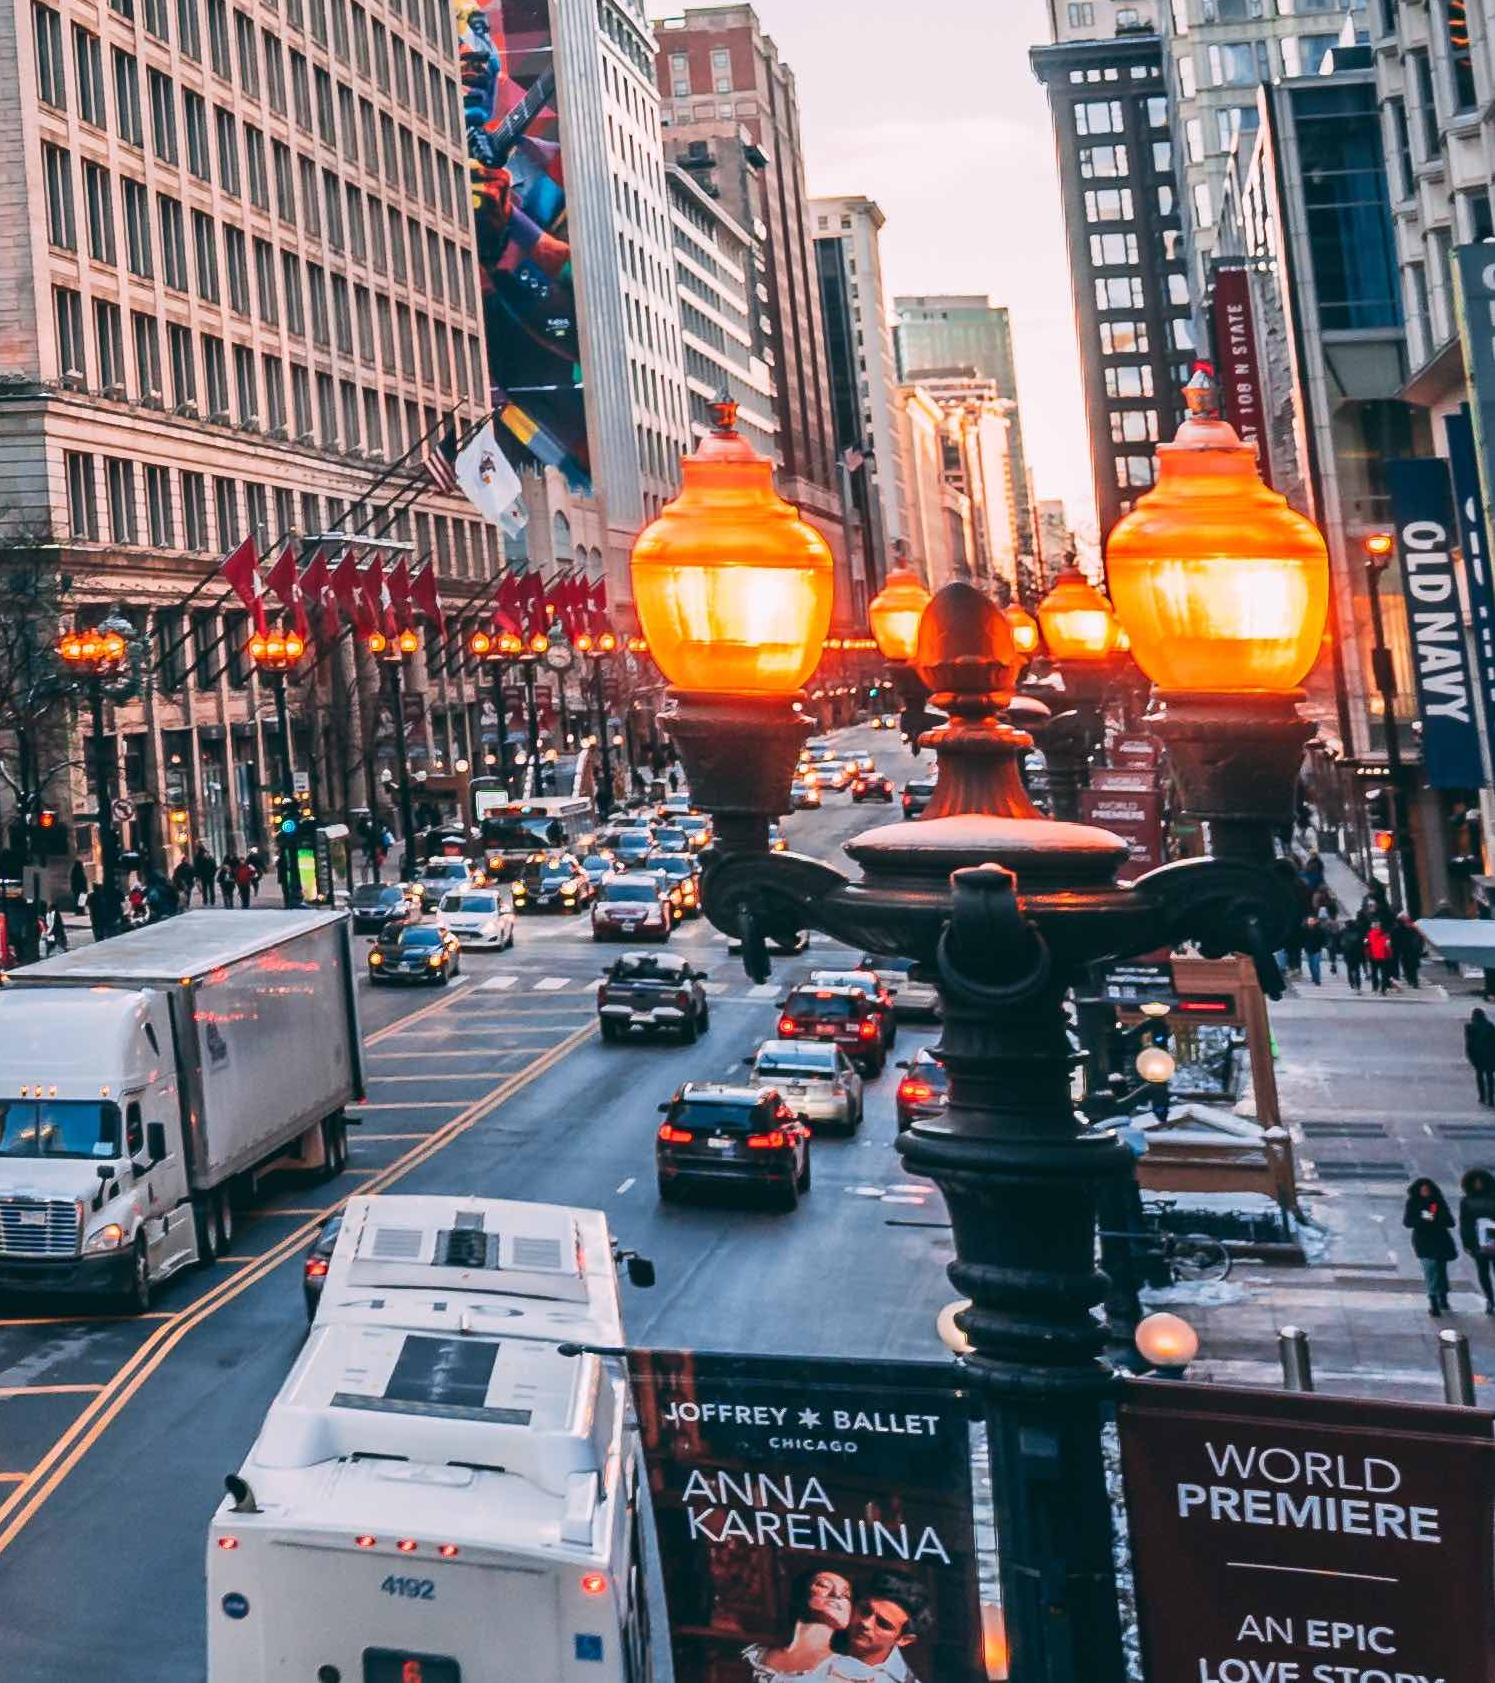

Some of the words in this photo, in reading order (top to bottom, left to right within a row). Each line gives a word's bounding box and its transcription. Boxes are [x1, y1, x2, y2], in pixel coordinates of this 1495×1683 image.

[1227, 303, 1249, 355] STATE
[1401, 520, 1452, 604] OLD
[1413, 612, 1469, 723] NAVY
[664, 1401, 788, 1427] JOFFREY
[833, 1409, 941, 1436] BALLET
[768, 1437, 858, 1453] CHICAGO
[1205, 1441, 1402, 1493] WORLD
[682, 1469, 835, 1513] ANNA
[1177, 1482, 1442, 1544] PREMIERE
[687, 1506, 951, 1565] KARENINA
[380, 1575, 437, 1601] 4192
[1237, 1614, 1294, 1645] AN
[1306, 1619, 1397, 1655] EPIC
[1199, 1657, 1300, 1683] LOVE
